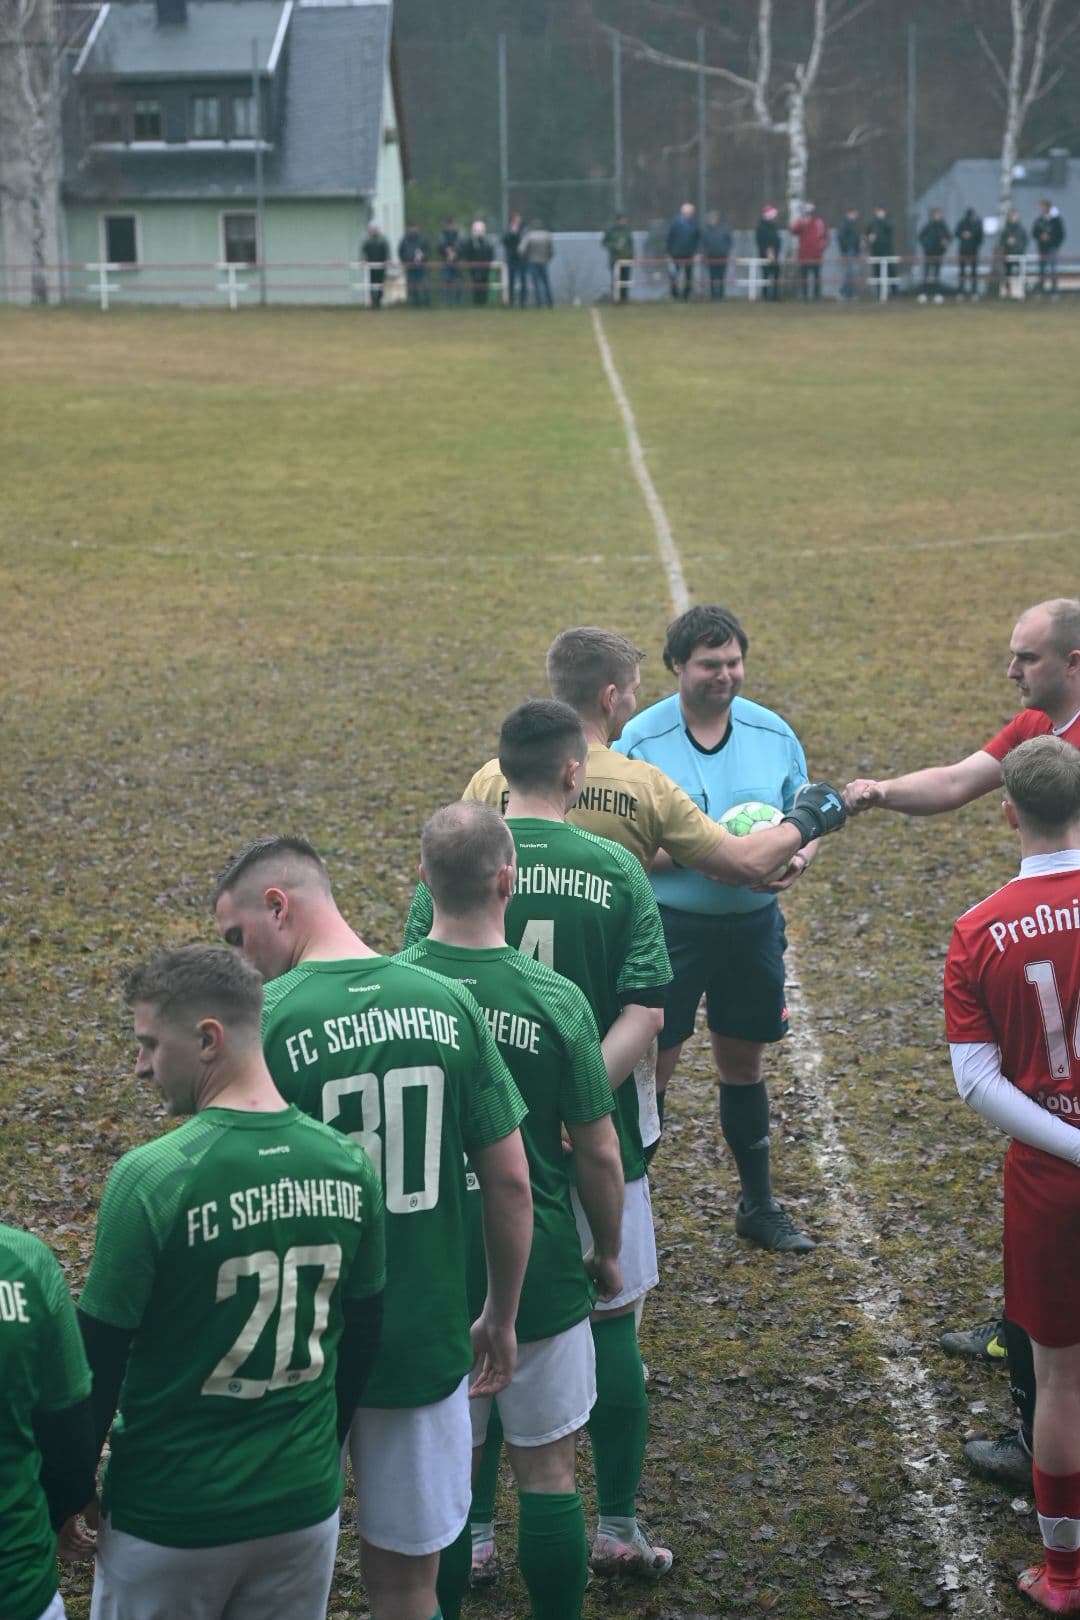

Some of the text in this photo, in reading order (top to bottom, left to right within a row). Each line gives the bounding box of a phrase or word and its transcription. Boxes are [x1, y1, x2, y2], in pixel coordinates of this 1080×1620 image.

[572, 786, 638, 821] NHEIDE
[512, 863, 613, 910] HÖNHEIDE
[518, 919, 554, 971] 4
[285, 1007, 461, 1073] FC SCHÖNHEIDE
[480, 1006, 541, 1055] HEIDE
[187, 1177, 363, 1247] FC SCHÖNHEIDE
[200, 1243, 342, 1400] 20
